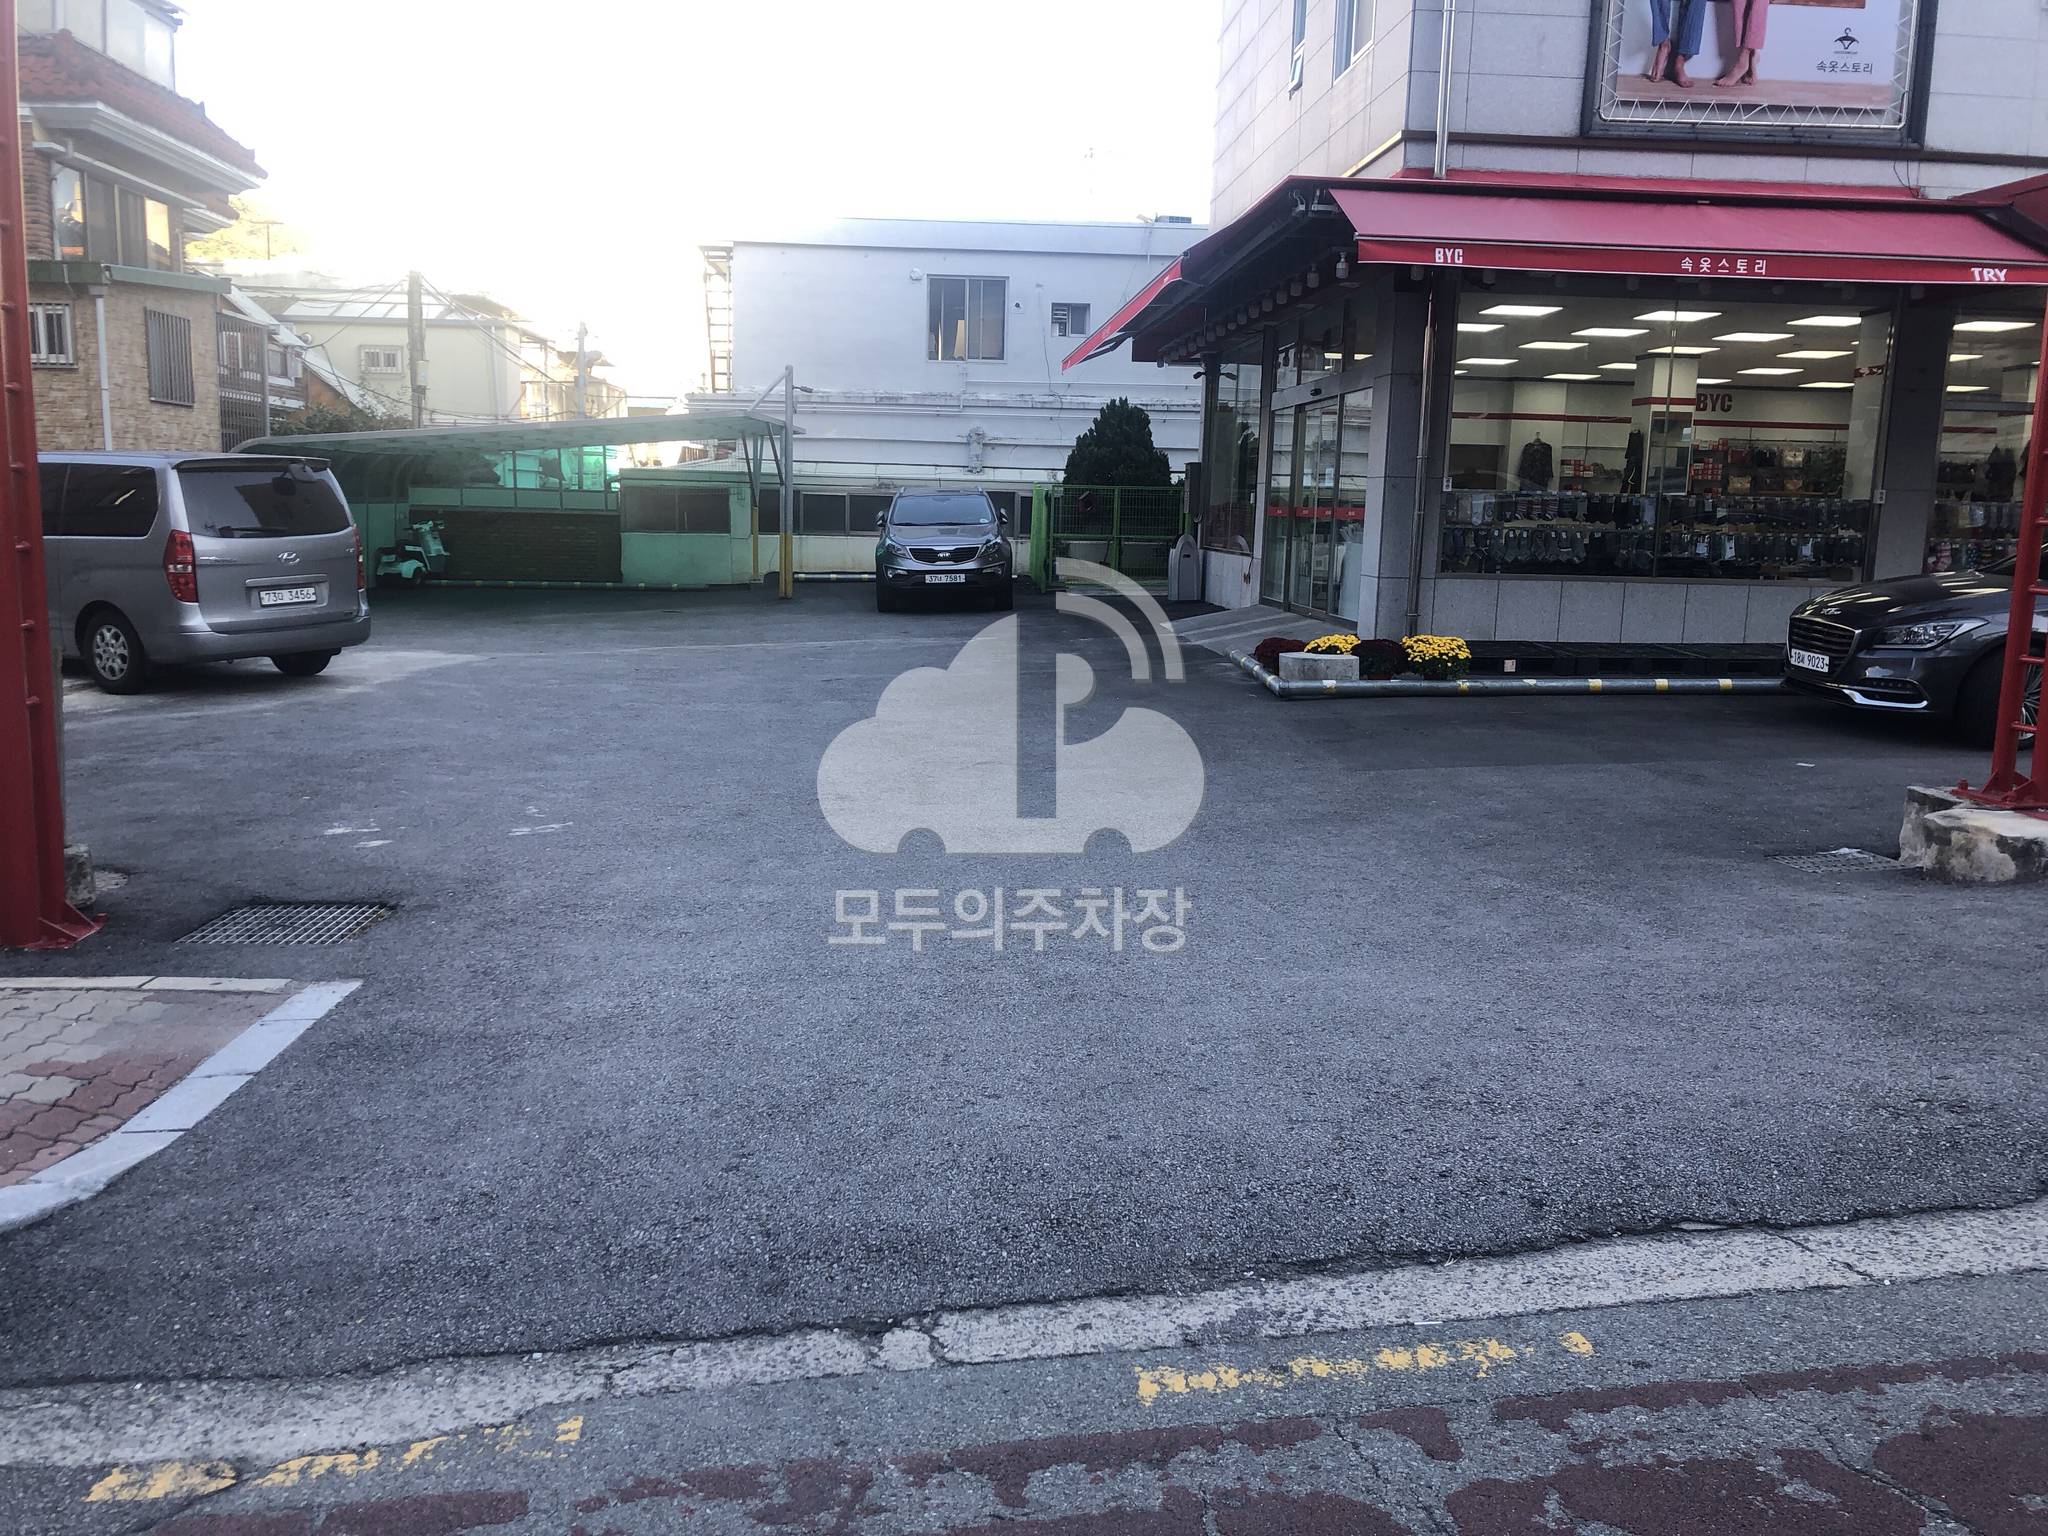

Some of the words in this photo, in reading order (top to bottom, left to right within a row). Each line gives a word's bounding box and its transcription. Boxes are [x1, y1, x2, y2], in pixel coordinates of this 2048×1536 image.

[1816, 60, 1873, 74] 속옷스토리
[1435, 247, 1463, 264] BYC
[1681, 256, 1767, 276] 속옷스토리
[1970, 267, 2008, 281] TRY
[1695, 392, 1733, 413] BYC
[287, 589, 312, 601] 3456
[1807, 654, 1826, 670] 9023
